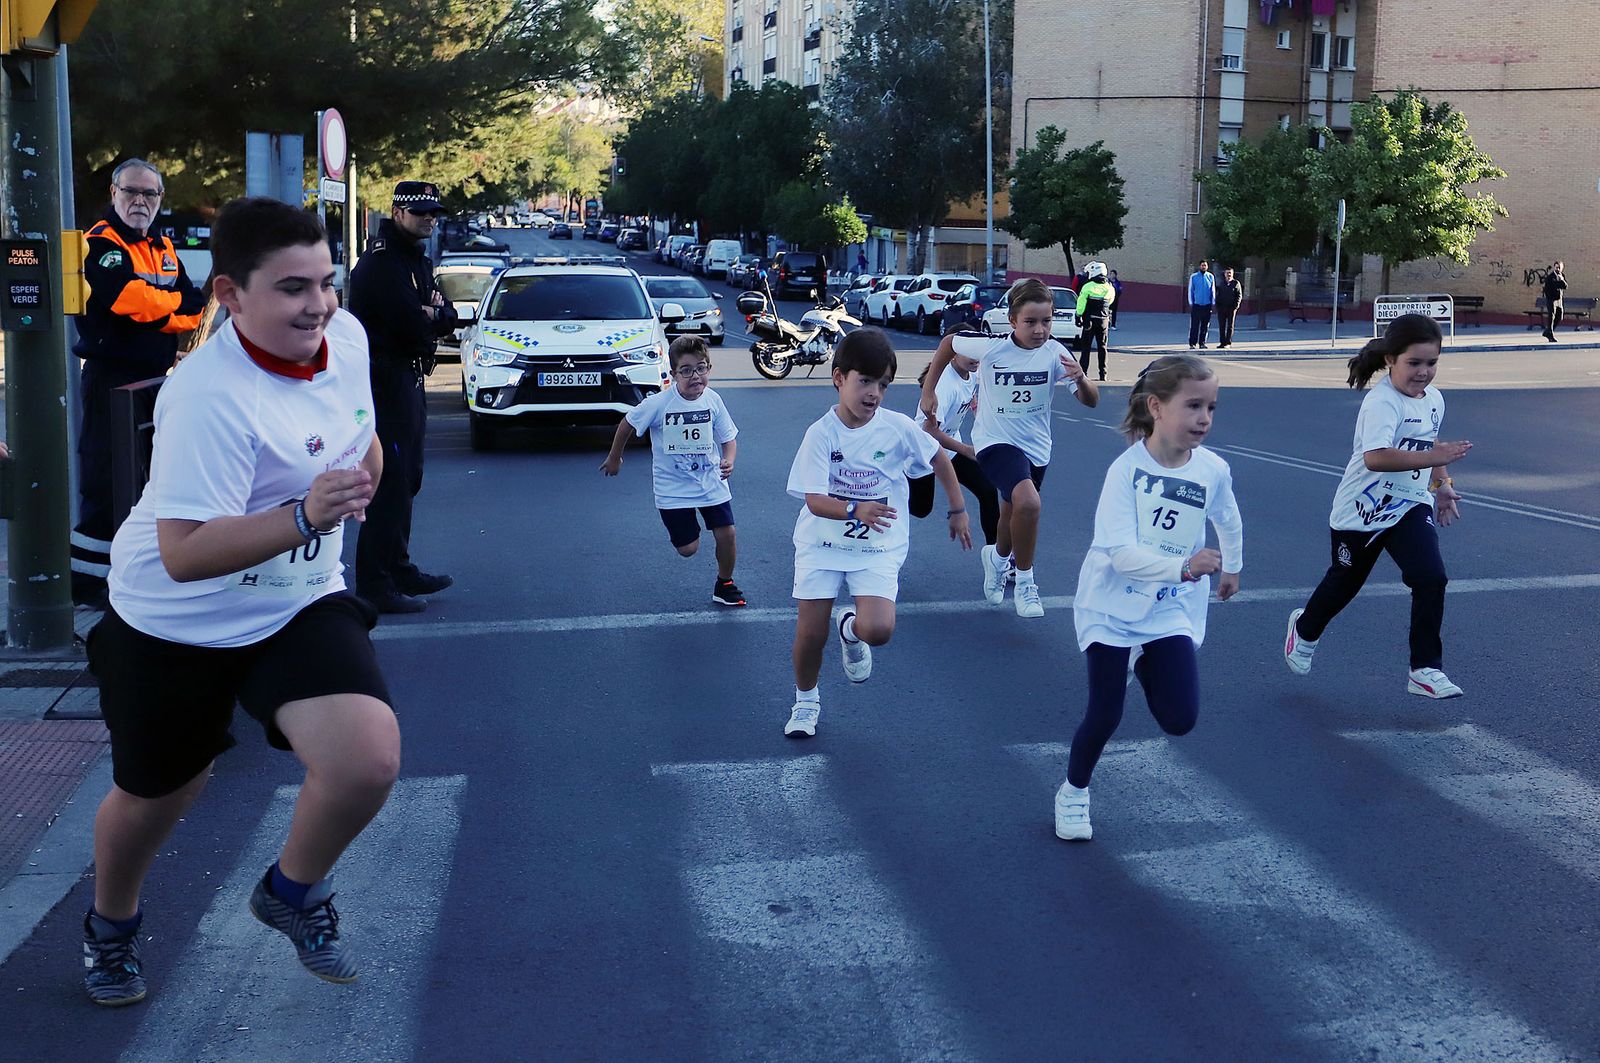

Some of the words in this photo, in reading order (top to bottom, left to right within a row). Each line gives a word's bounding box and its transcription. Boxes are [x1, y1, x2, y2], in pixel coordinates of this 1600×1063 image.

[11, 249, 34, 257] PULSE
[8, 257, 39, 265] PEATON
[10, 285, 40, 294] ESPERE
[12, 295, 38, 304] VERDE
[1378, 303, 1431, 311] POLIDEPORTIVO
[1378, 310, 1398, 318] DIEGO
[545, 374, 574, 385] 9926
[577, 373, 599, 385] KZX
[1011, 390, 1032, 403] 23
[682, 428, 701, 440] 16
[844, 469, 875, 478] Carrera
[1152, 506, 1179, 531] 15
[843, 521, 870, 540] 22
[1159, 543, 1182, 555] HUELVA
